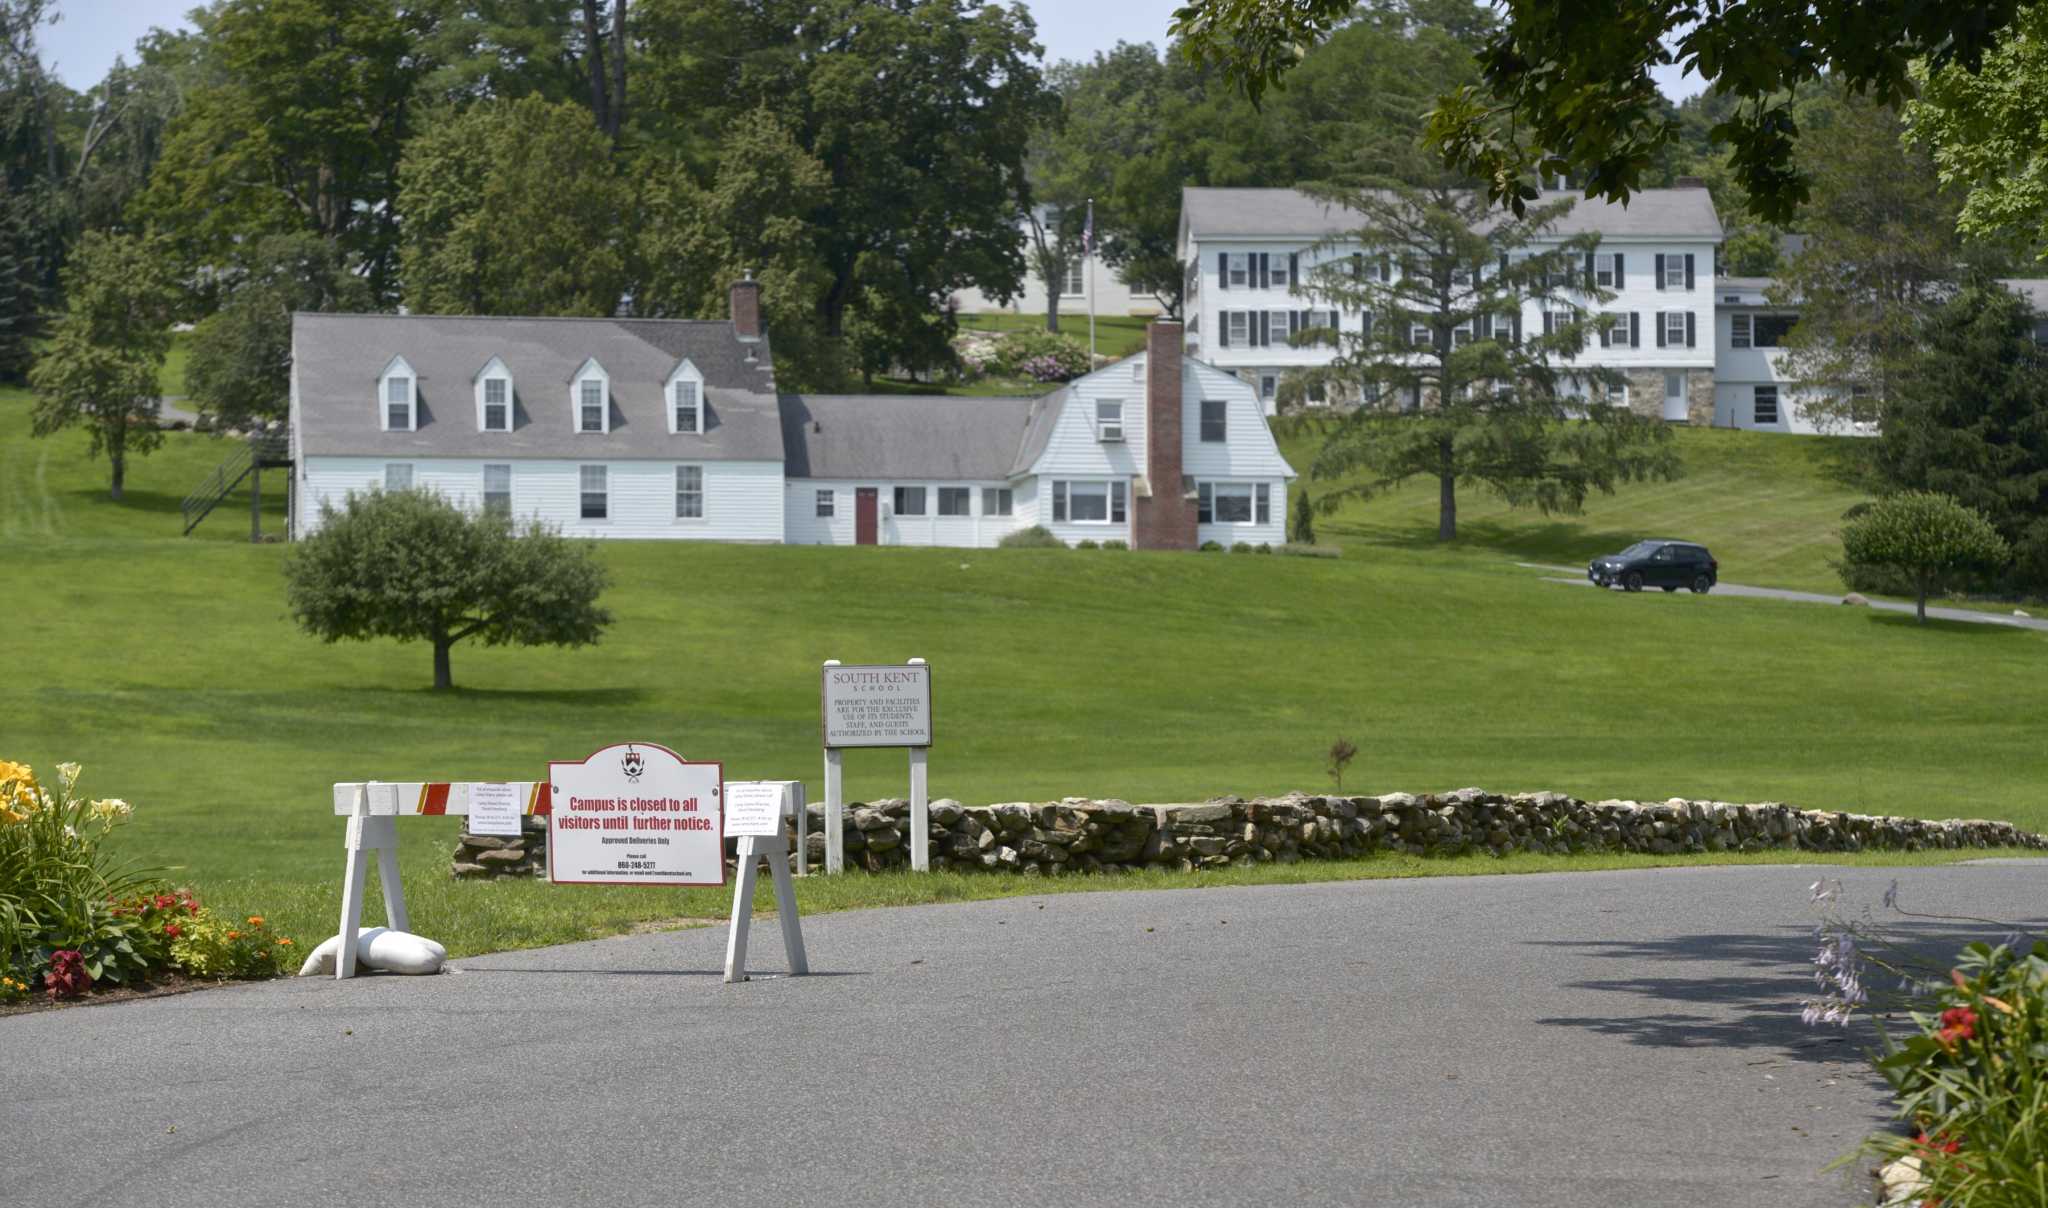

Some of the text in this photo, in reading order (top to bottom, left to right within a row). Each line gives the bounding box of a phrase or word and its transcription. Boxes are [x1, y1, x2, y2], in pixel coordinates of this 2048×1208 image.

[833, 672, 920, 683] SOUTH KENT
[870, 698, 884, 706] AND
[886, 697, 920, 705] FACILITIES
[880, 712, 914, 720] STUDENTS,
[846, 721, 867, 729] STAFF,
[885, 720, 909, 728] GUESTS
[830, 729, 872, 737] AUTHORIZED
[570, 796, 698, 812] Campus is closed to all
[558, 815, 600, 830] visitors
[603, 815, 628, 830] until
[633, 815, 671, 830] further
[674, 816, 713, 831] notice.
[602, 837, 670, 846] Approved Deliveries Only
